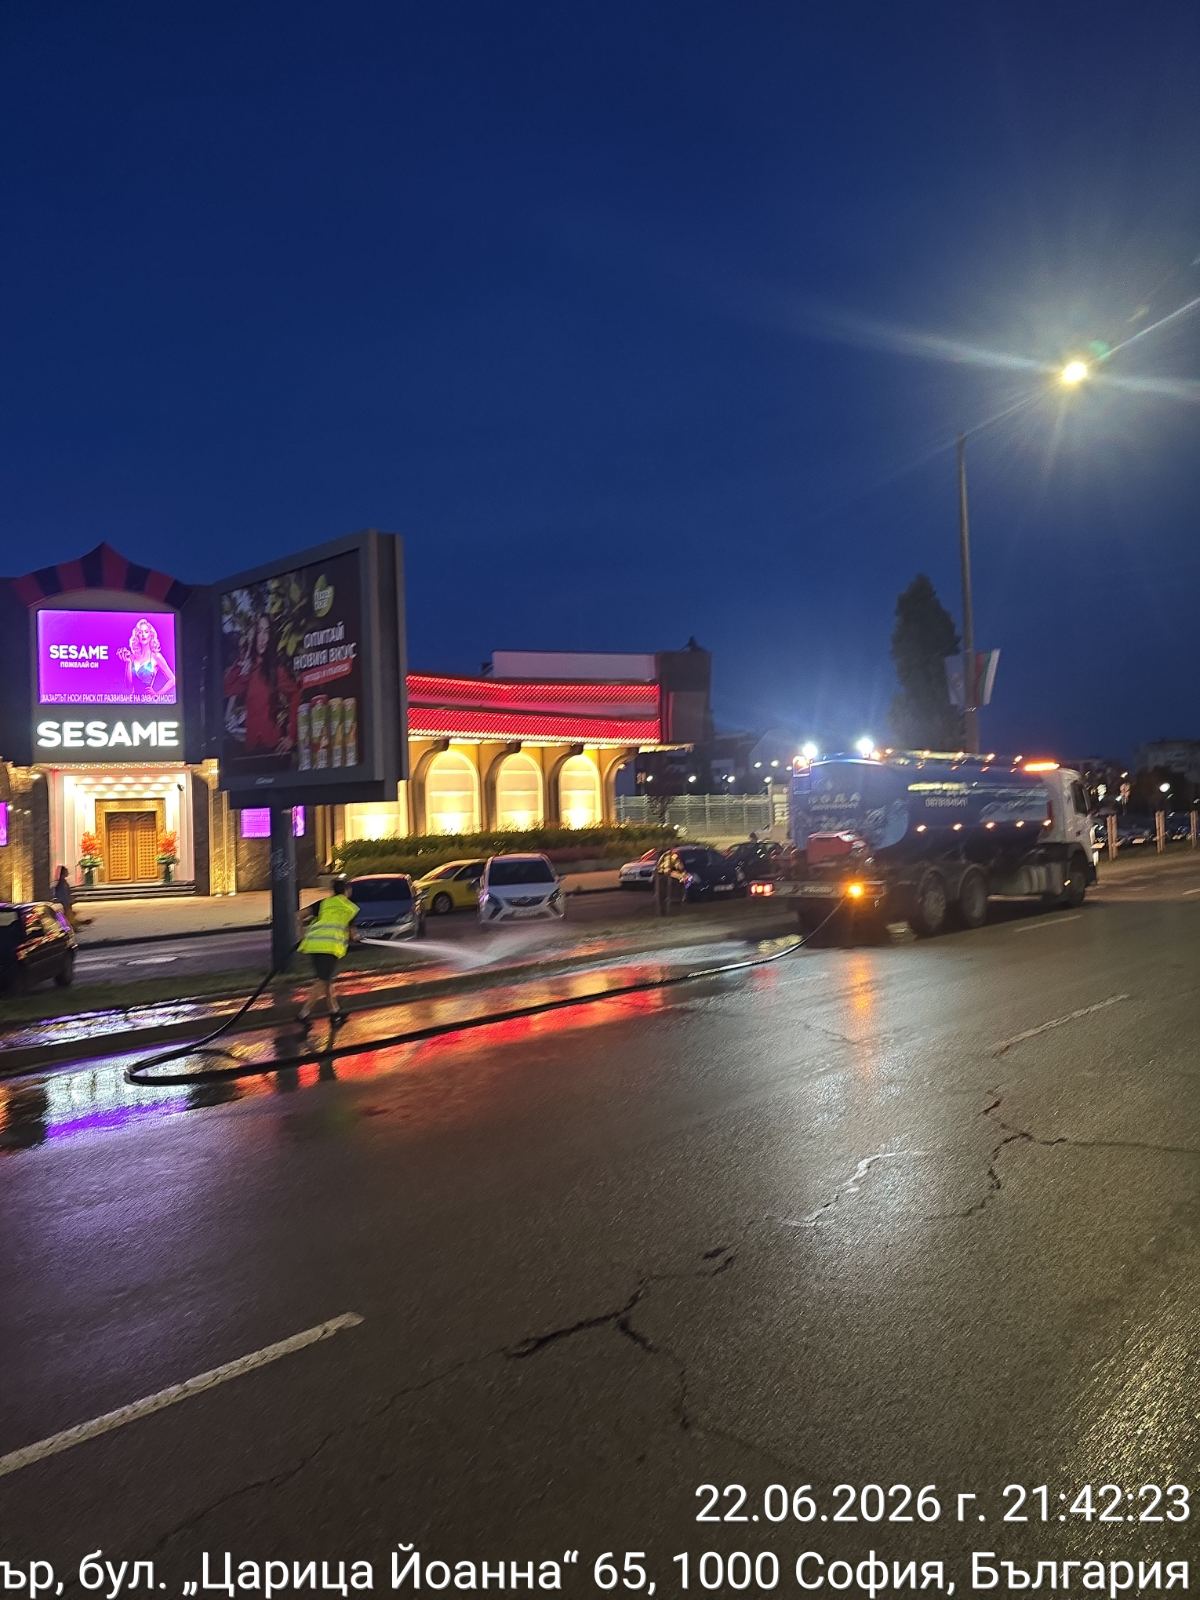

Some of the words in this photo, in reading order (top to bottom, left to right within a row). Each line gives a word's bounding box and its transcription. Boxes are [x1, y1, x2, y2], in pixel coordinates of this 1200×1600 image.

[303, 621, 345, 648] ОПИТАЙ
[49, 645, 109, 659] SESAME
[293, 649, 328, 670] НОВИЯ
[328, 642, 357, 662] ВКУС
[60, 660, 89, 668] ПОЖЕЛАЙ
[89, 661, 99, 669] СИ
[67, 694, 82, 703] НОСИ
[96, 694, 104, 703] ОТ
[133, 694, 141, 703] НА
[36, 720, 180, 748] SESAME
